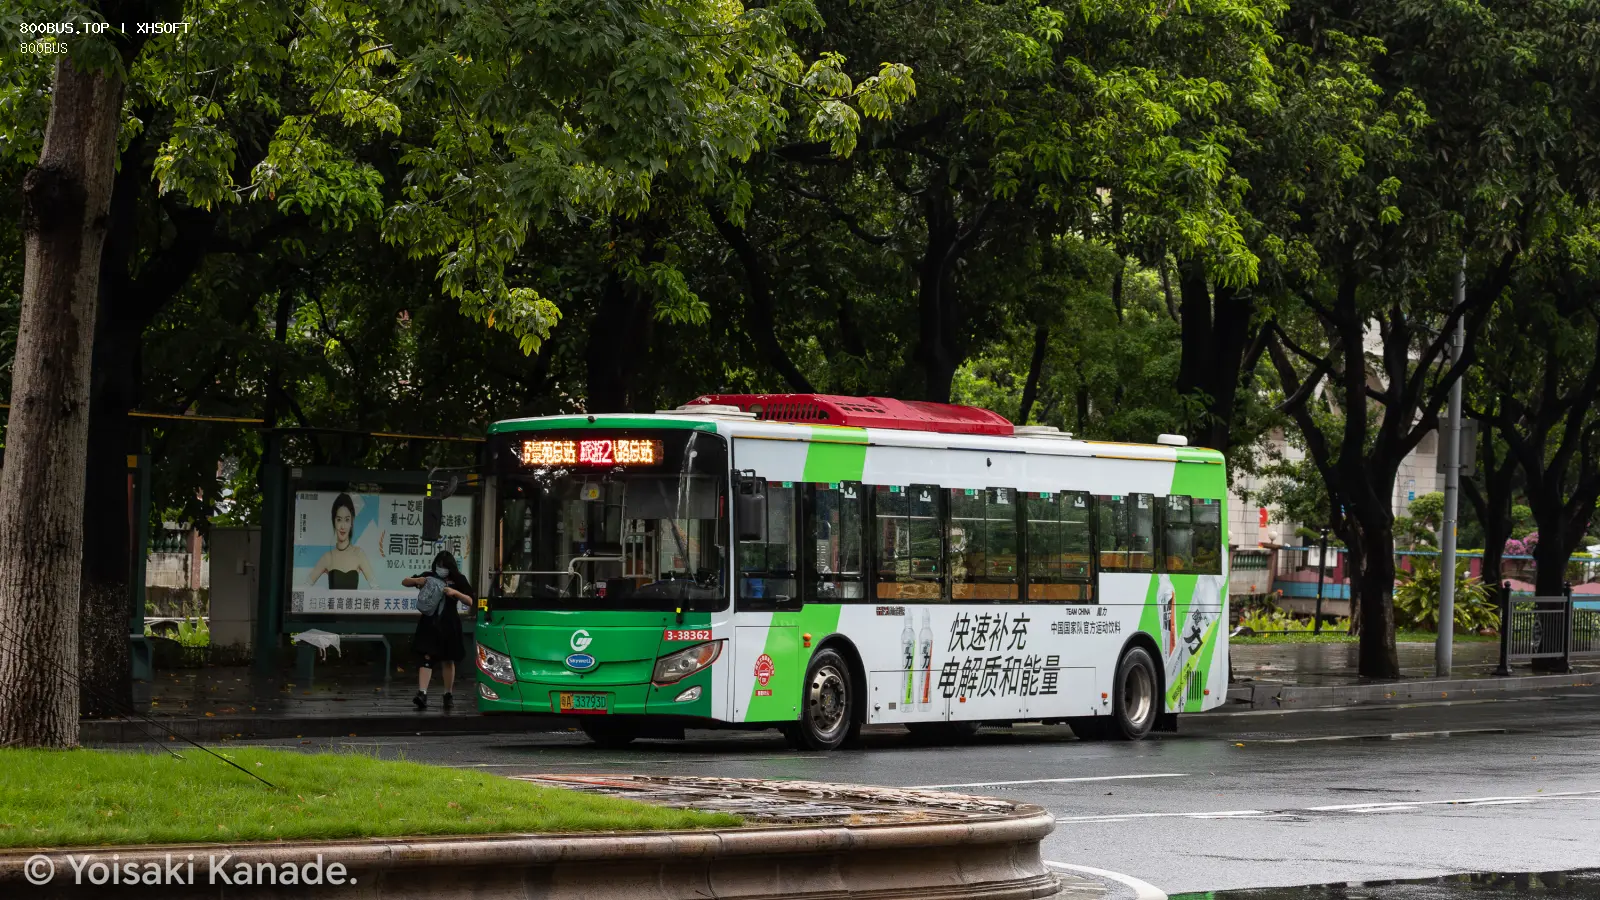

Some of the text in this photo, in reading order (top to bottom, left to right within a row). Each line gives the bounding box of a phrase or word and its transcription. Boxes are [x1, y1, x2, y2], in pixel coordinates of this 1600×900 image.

[667, 631, 709, 640] 3-38362
[947, 612, 1030, 652] 快速补充
[1050, 621, 1121, 635] 中国国家队官方运动饮料
[937, 654, 1061, 698] 电解质和能量
